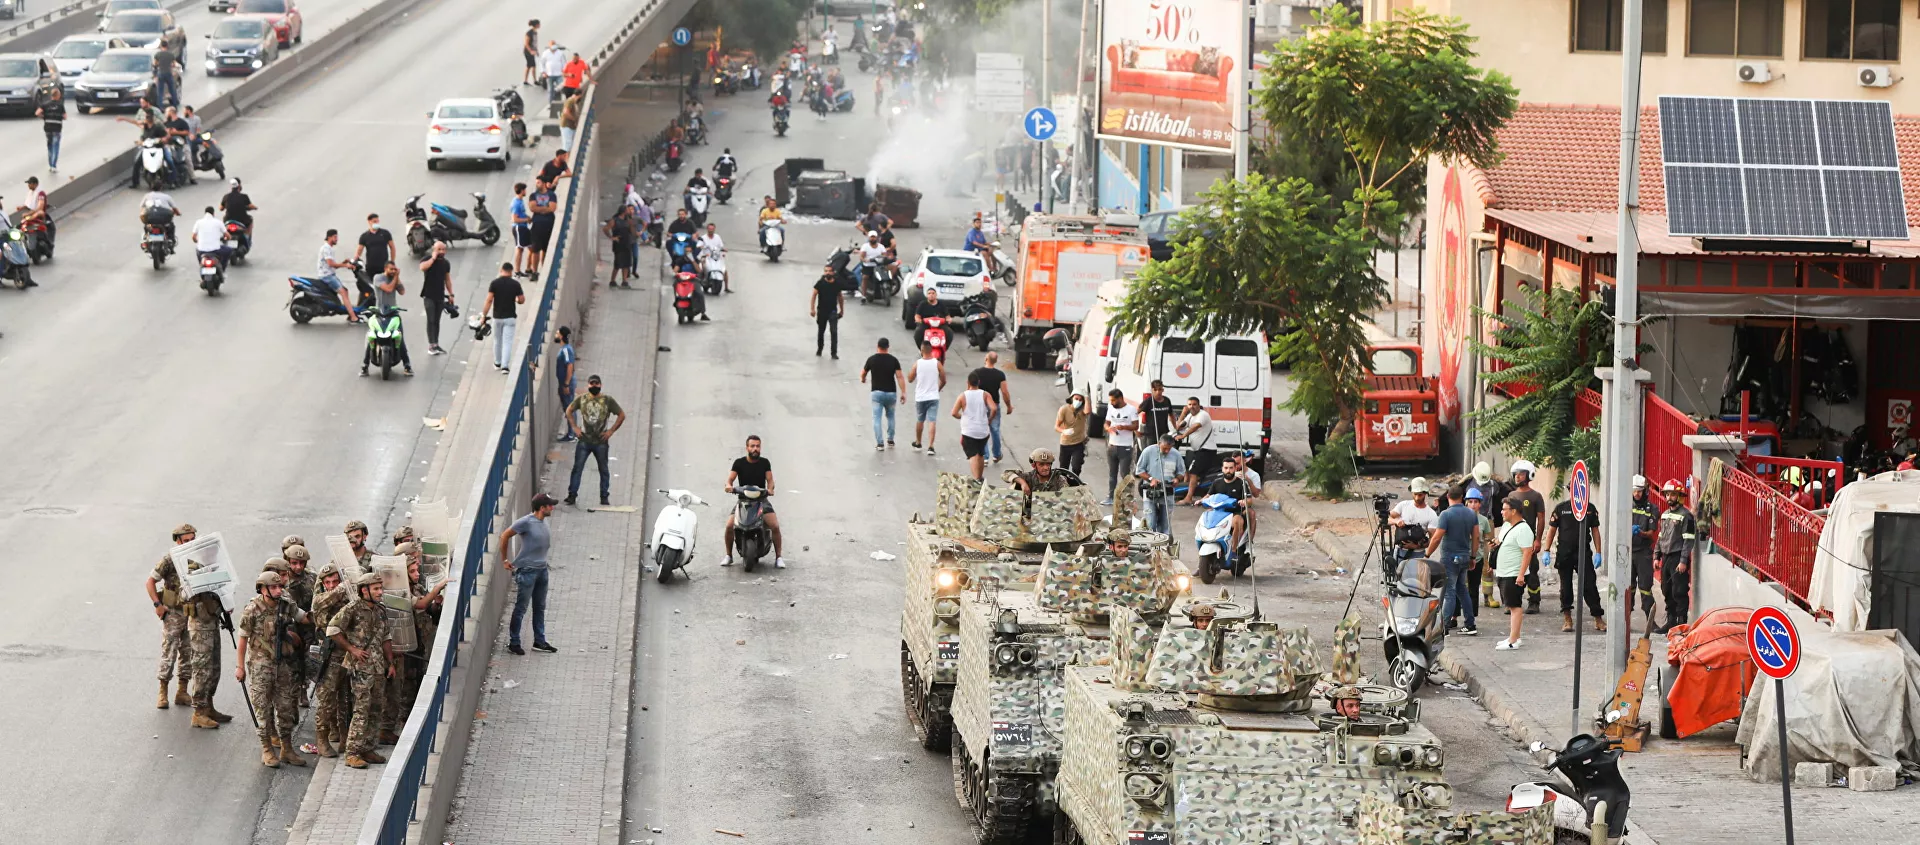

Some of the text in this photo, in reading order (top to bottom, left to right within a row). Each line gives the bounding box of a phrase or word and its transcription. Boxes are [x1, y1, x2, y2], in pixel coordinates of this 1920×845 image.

[1146, 0, 1200, 44] 50%
[1124, 109, 1191, 137] istikbal
[1187, 127, 1196, 138] 81
[1202, 129, 1212, 140] 59
[1213, 130, 1223, 141] 59
[1223, 131, 1233, 142] 16
[1771, 625, 1789, 637] ممنوع
[941, 652, 960, 660] ٥١٧
[1757, 645, 1775, 657] الوقوف
[995, 732, 1031, 743] ٥١٧٦٤٠
[1147, 833, 1168, 841] الجيش
